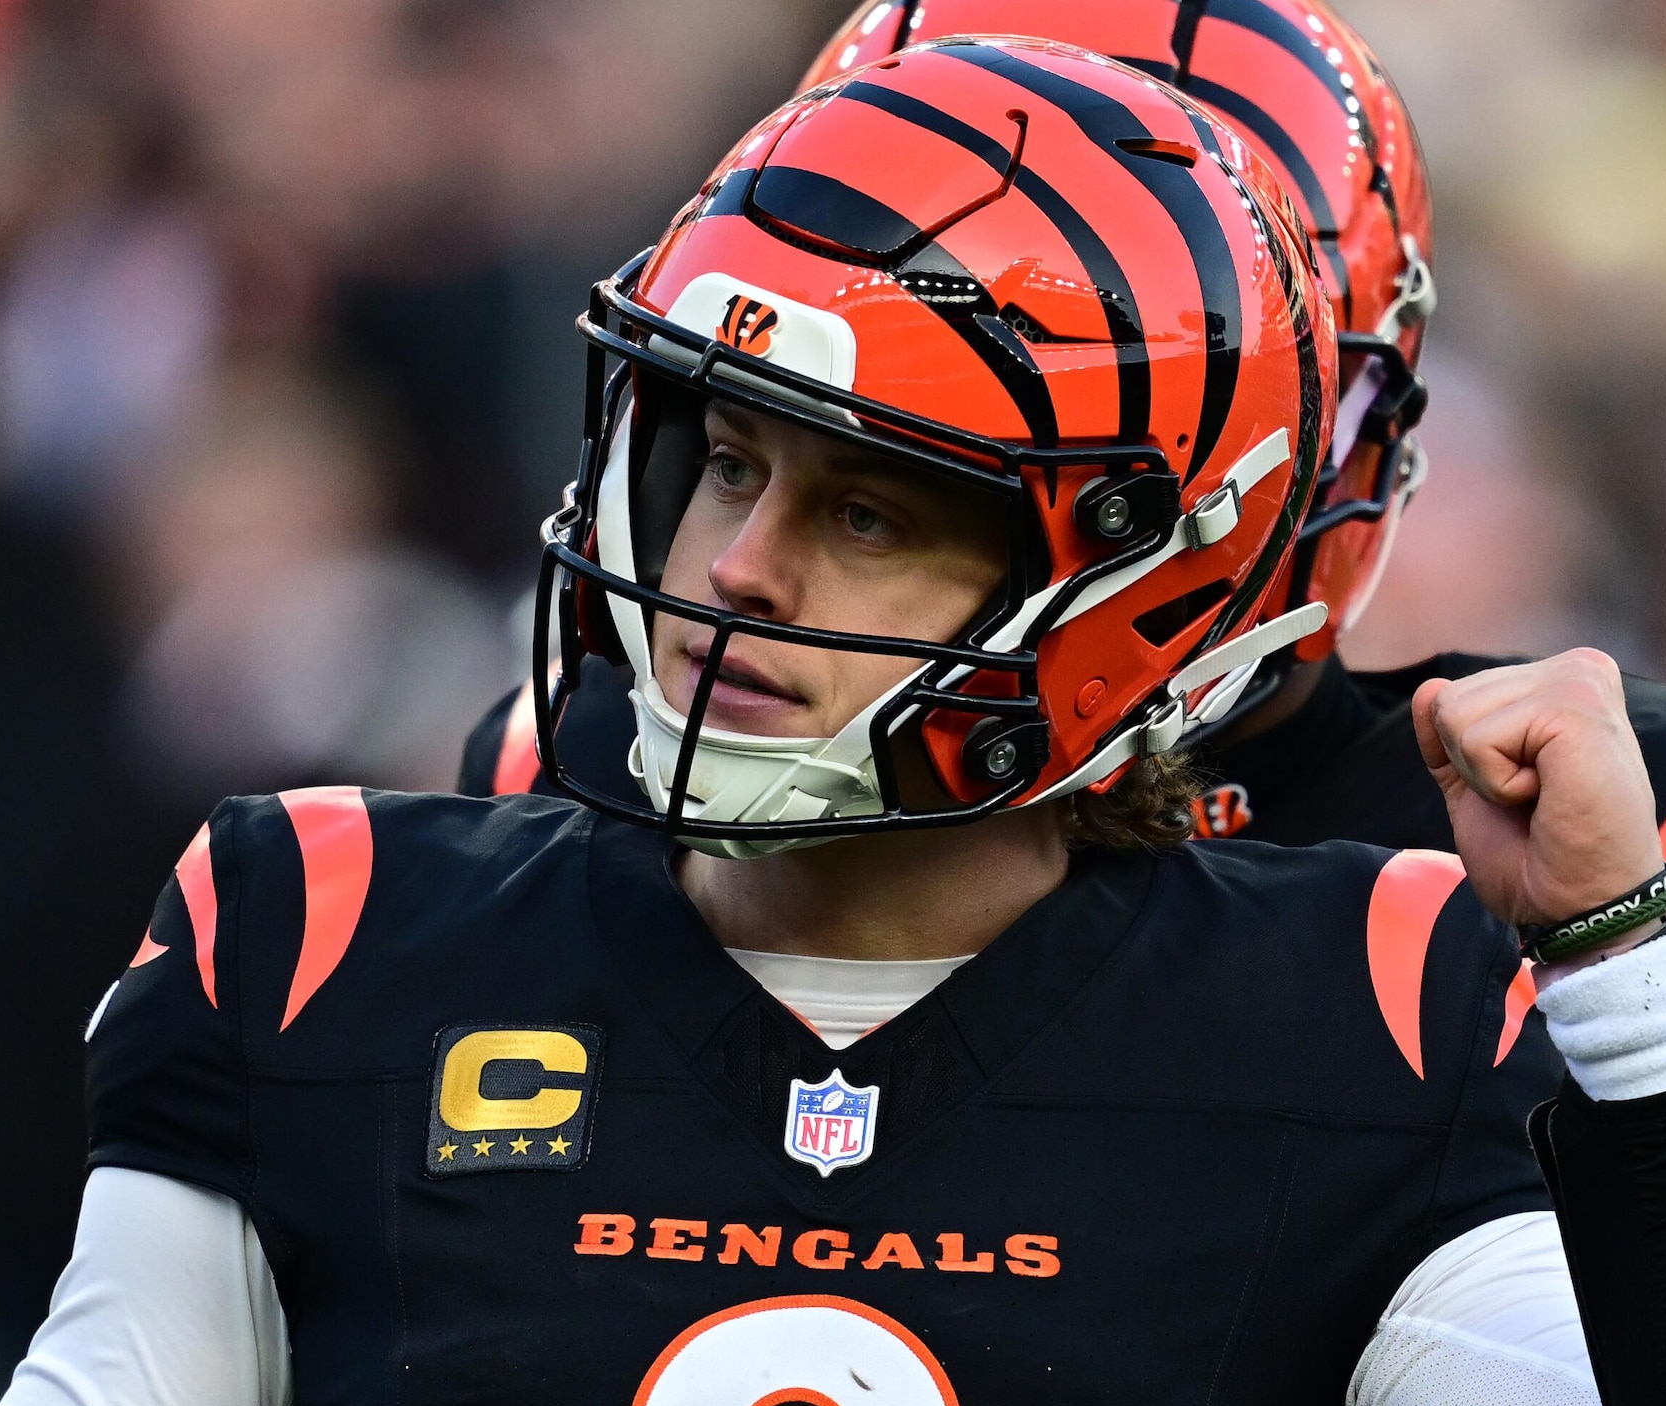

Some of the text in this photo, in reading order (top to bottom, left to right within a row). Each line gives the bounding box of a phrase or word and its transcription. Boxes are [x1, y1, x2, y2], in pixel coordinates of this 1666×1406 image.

[440, 1030, 588, 1131] C
[799, 1116, 858, 1156] NFL
[575, 1213, 1062, 1278] BENGALS
